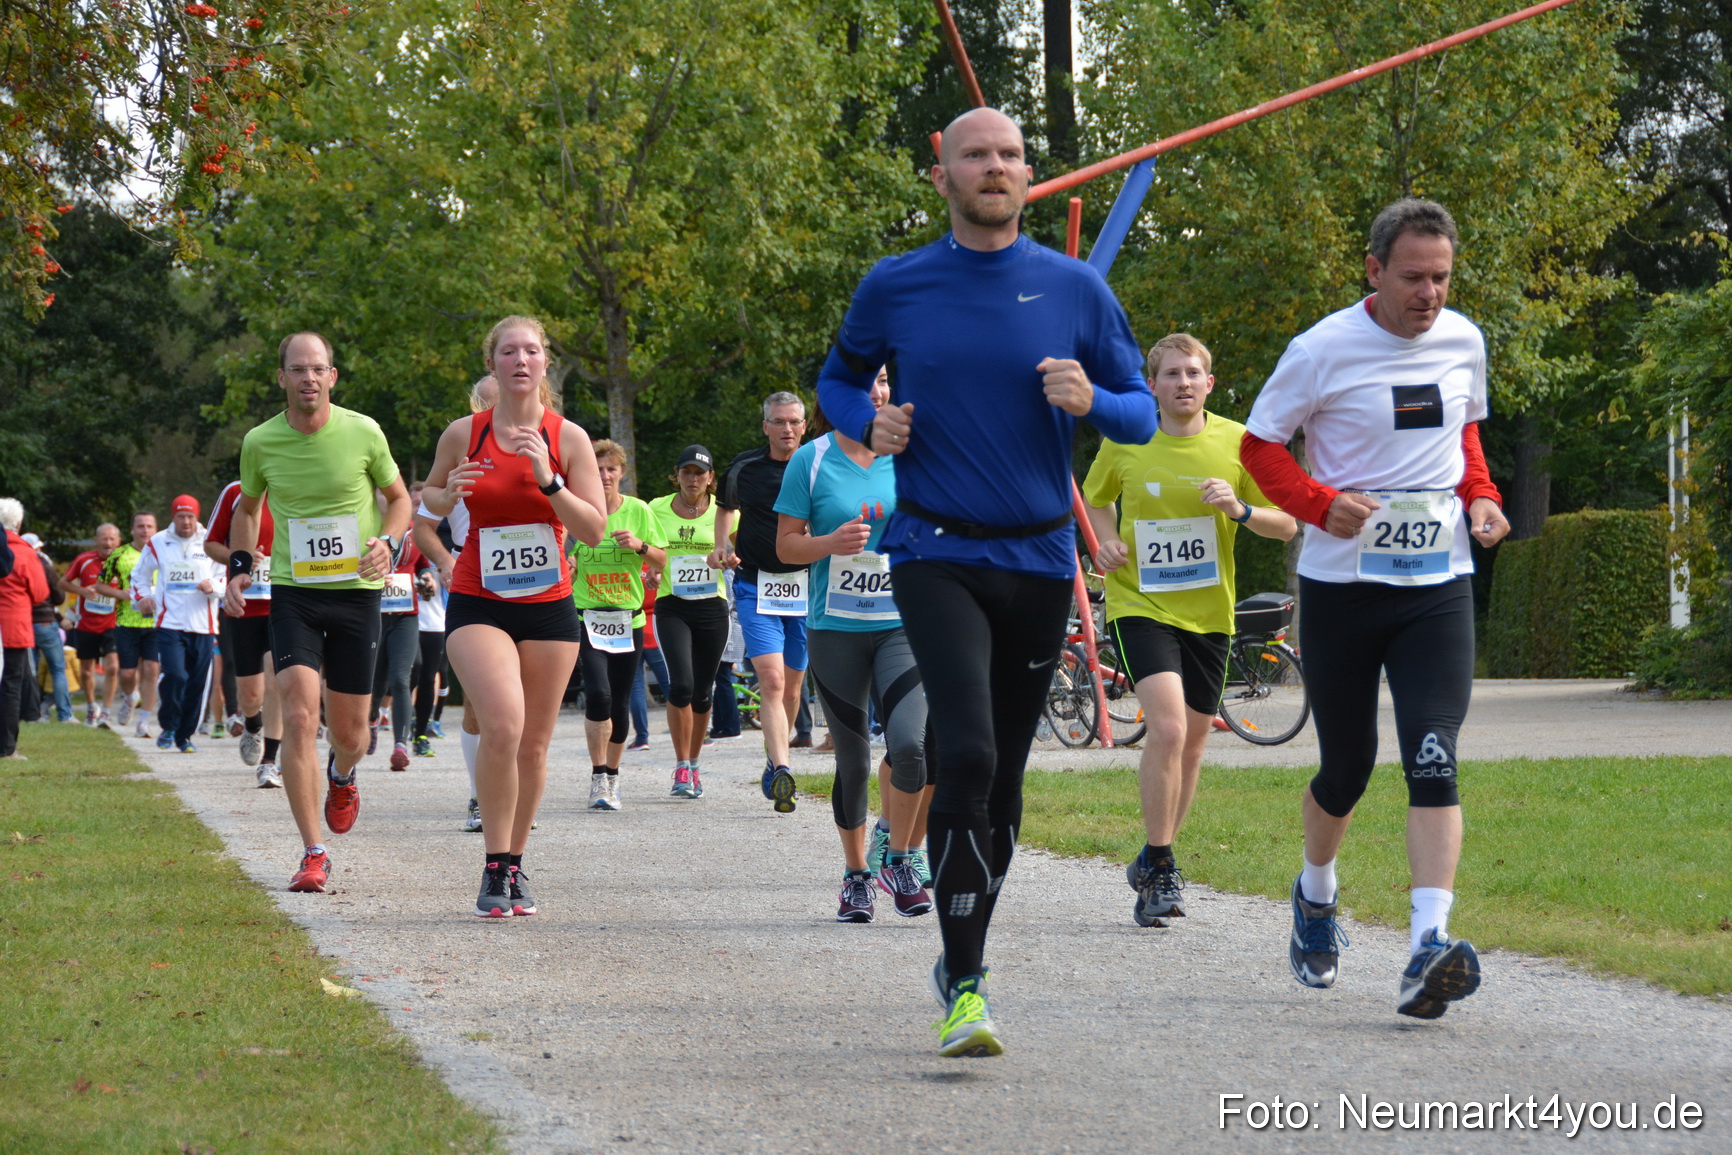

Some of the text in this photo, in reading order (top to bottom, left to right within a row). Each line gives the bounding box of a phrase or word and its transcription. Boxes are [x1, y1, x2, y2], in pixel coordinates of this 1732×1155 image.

[1374, 521, 1442, 549] 2437
[306, 536, 343, 557] 195
[1147, 539, 1205, 564] 2146
[492, 546, 548, 571] 2153
[1392, 558, 1423, 570] Martin
[309, 563, 344, 572] Alexander
[1159, 568, 1198, 579] Alexander
[170, 572, 195, 581] 2244
[508, 575, 535, 585] Marina
[586, 572, 631, 586] MERZ
[678, 568, 710, 583] 2271
[840, 570, 892, 593] 2402
[588, 584, 631, 595] PREMIUM
[764, 582, 800, 598] 2390
[856, 600, 875, 608] Julia
[591, 622, 625, 636] 2203
[1412, 766, 1452, 778] odlo
